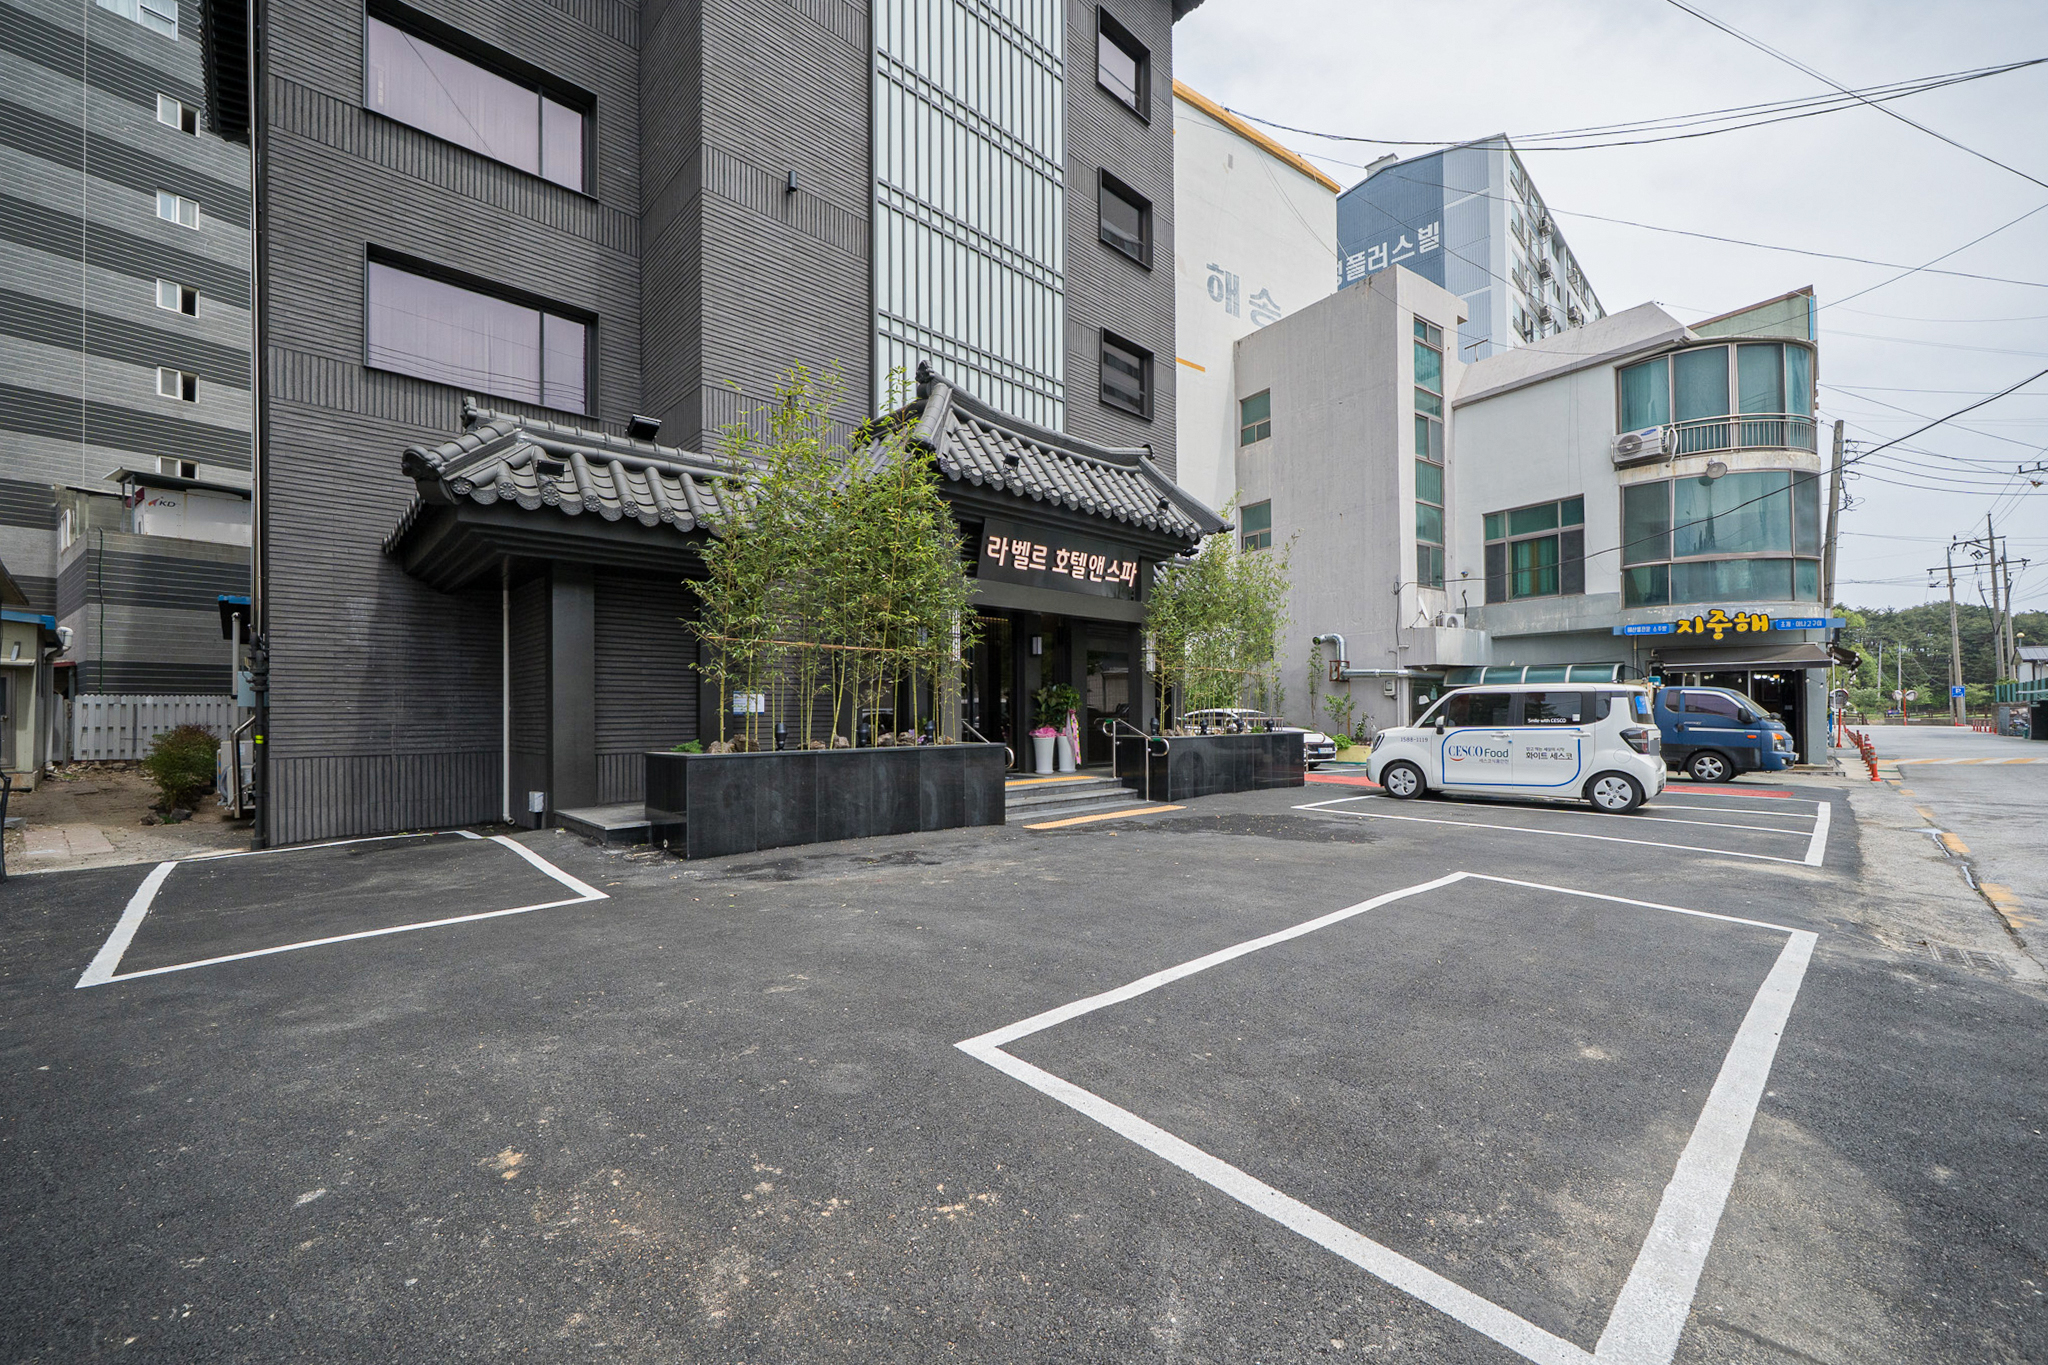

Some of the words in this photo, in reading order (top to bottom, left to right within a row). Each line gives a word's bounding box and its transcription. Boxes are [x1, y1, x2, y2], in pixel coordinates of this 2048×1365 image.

[987, 535, 1048, 571] 라벨르
[1052, 548, 1137, 588] 호텔앤스파
[1676, 609, 1770, 640] 지중해
[1448, 745, 1483, 757] CESCO
[1484, 748, 1509, 758] Food
[1526, 751, 1548, 760] 화이트
[1550, 752, 1573, 760] 세스코
